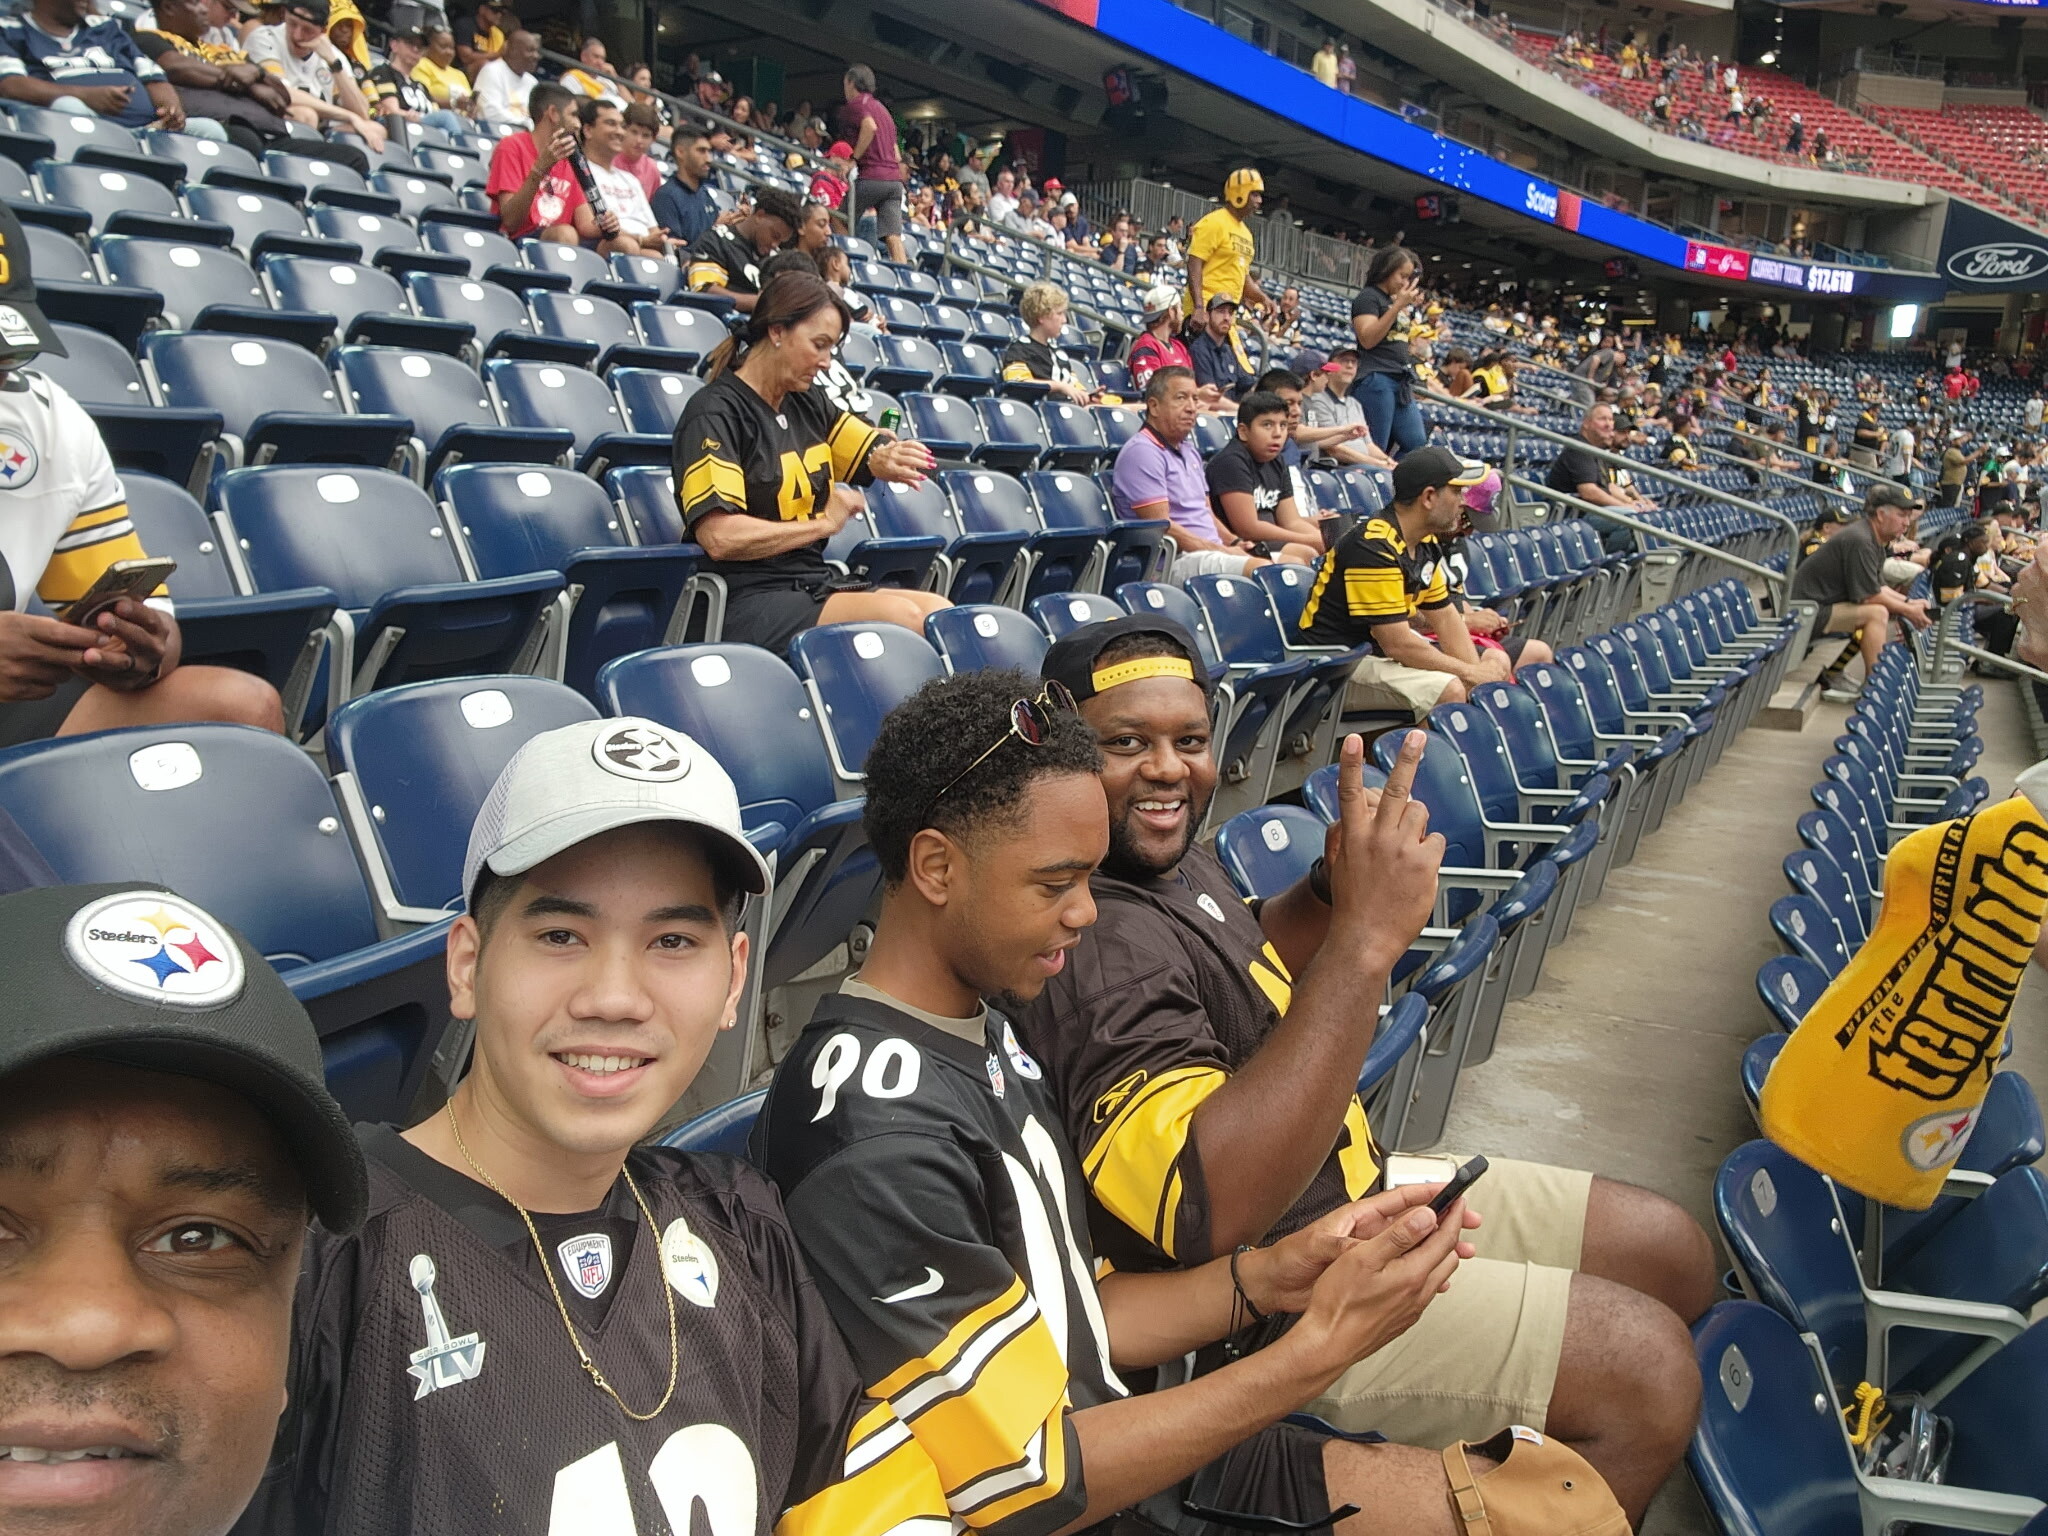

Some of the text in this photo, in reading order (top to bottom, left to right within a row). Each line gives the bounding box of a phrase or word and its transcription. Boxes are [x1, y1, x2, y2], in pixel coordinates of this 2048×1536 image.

[1525, 182, 1557, 219] Score
[1751, 257, 1784, 282] CURRENT
[1783, 263, 1804, 286] TOTAL
[1966, 248, 2033, 276] Ford
[982, 619, 991, 631] 9
[1270, 828, 1280, 842] 8
[88, 928, 158, 945] Steelers
[1845, 977, 1894, 1040] MYRON
[1932, 815, 1971, 909] OFFICIAL
[1868, 991, 1905, 1037] The
[810, 1033, 921, 1123] 90
[1758, 1180, 1768, 1200] 7
[567, 1240, 606, 1257] EQUIPMENT
[582, 1266, 604, 1285] NFL
[443, 1337, 474, 1352] BOWL
[406, 1342, 486, 1401] XLV
[1729, 1363, 1741, 1387] 6
